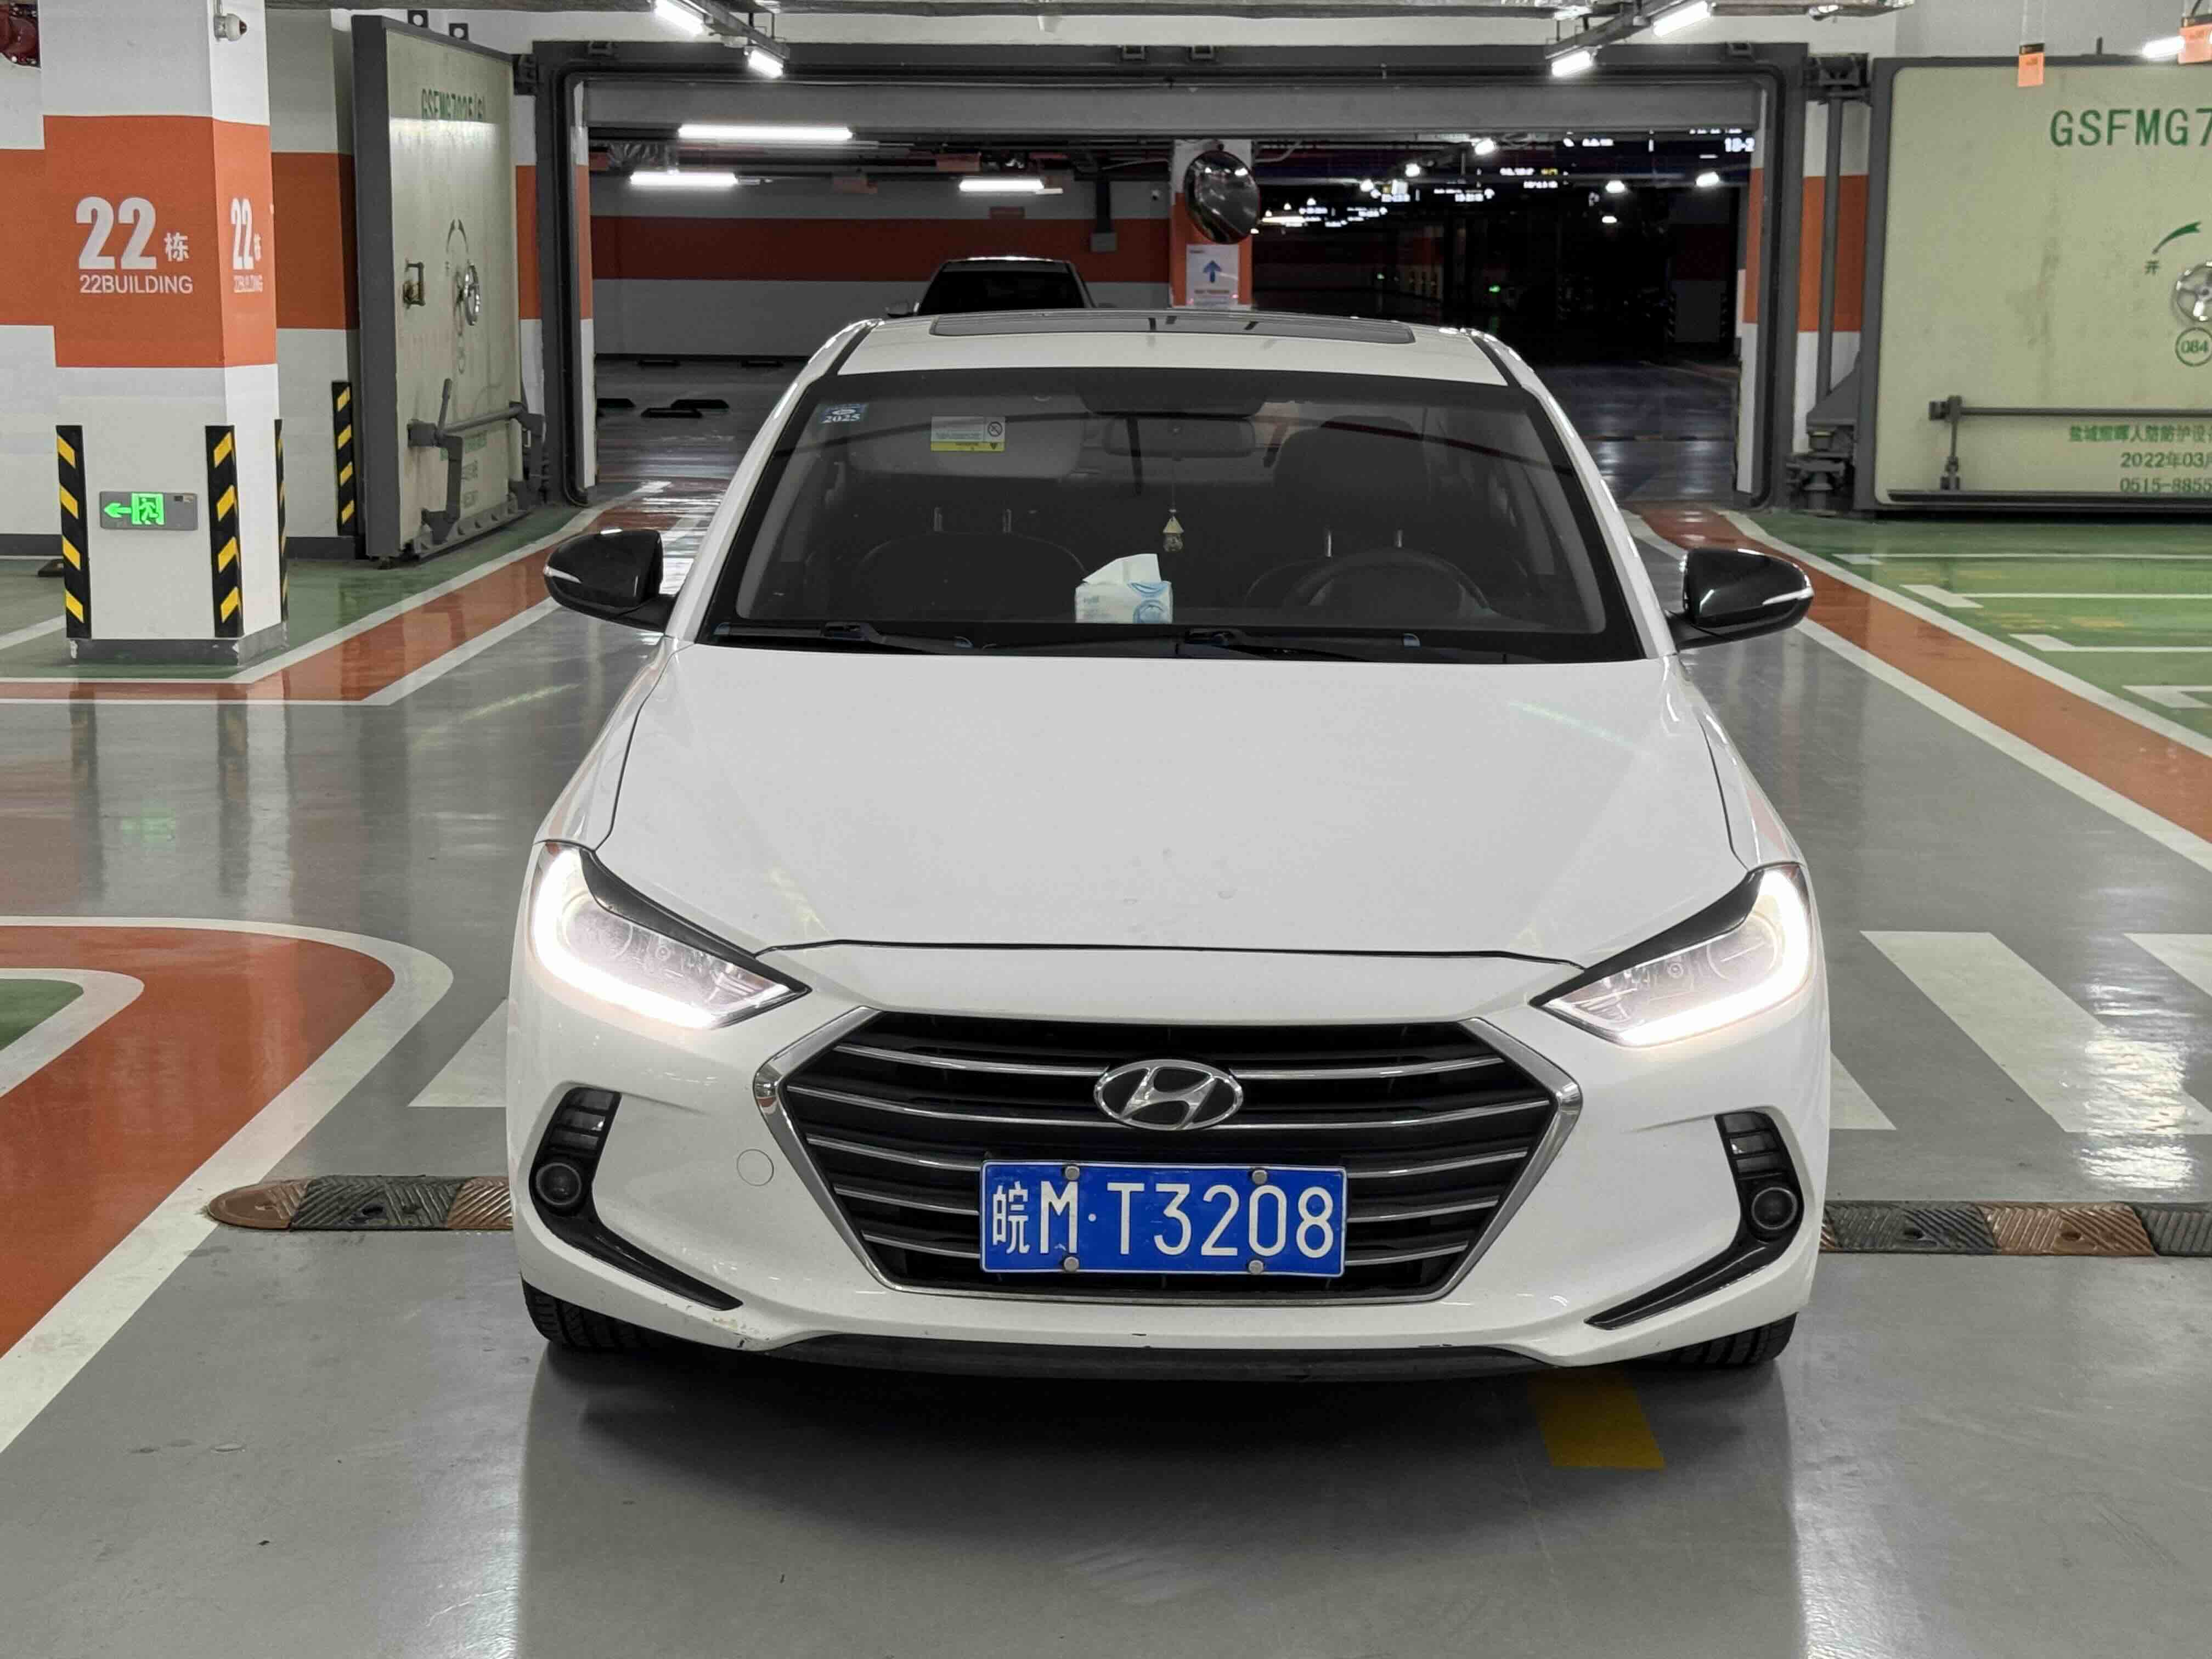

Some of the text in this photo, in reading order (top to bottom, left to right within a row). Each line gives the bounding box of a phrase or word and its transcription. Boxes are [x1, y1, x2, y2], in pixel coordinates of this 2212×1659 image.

[2050, 108, 2212, 146] GSFMG7
[80, 275, 193, 294] 22BUILDING
[992, 1180, 1335, 1259] 皖M·T3208
